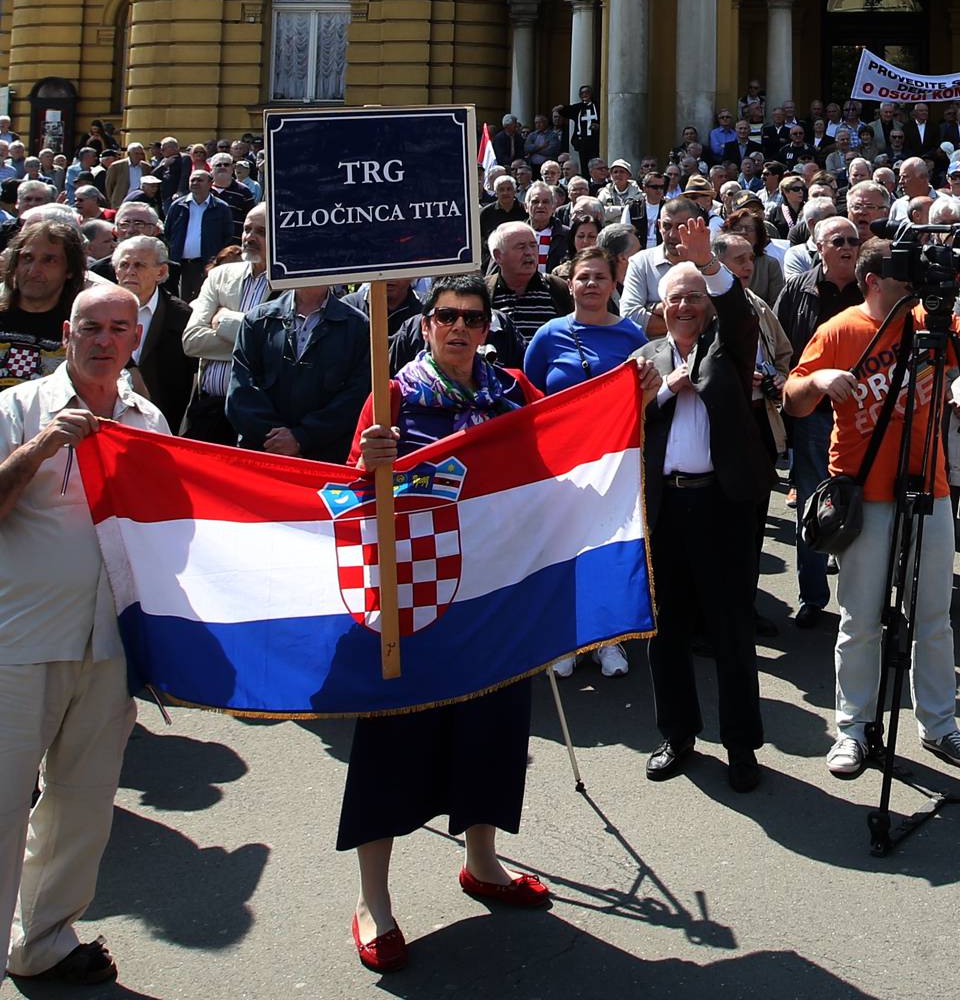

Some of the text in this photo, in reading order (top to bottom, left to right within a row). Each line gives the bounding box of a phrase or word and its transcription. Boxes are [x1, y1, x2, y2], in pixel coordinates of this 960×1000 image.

[862, 82, 874, 94] O
[868, 60, 947, 90] PROVEDITE
[337, 159, 405, 185] TRG
[279, 200, 462, 228] ZLOČINCA TITA
